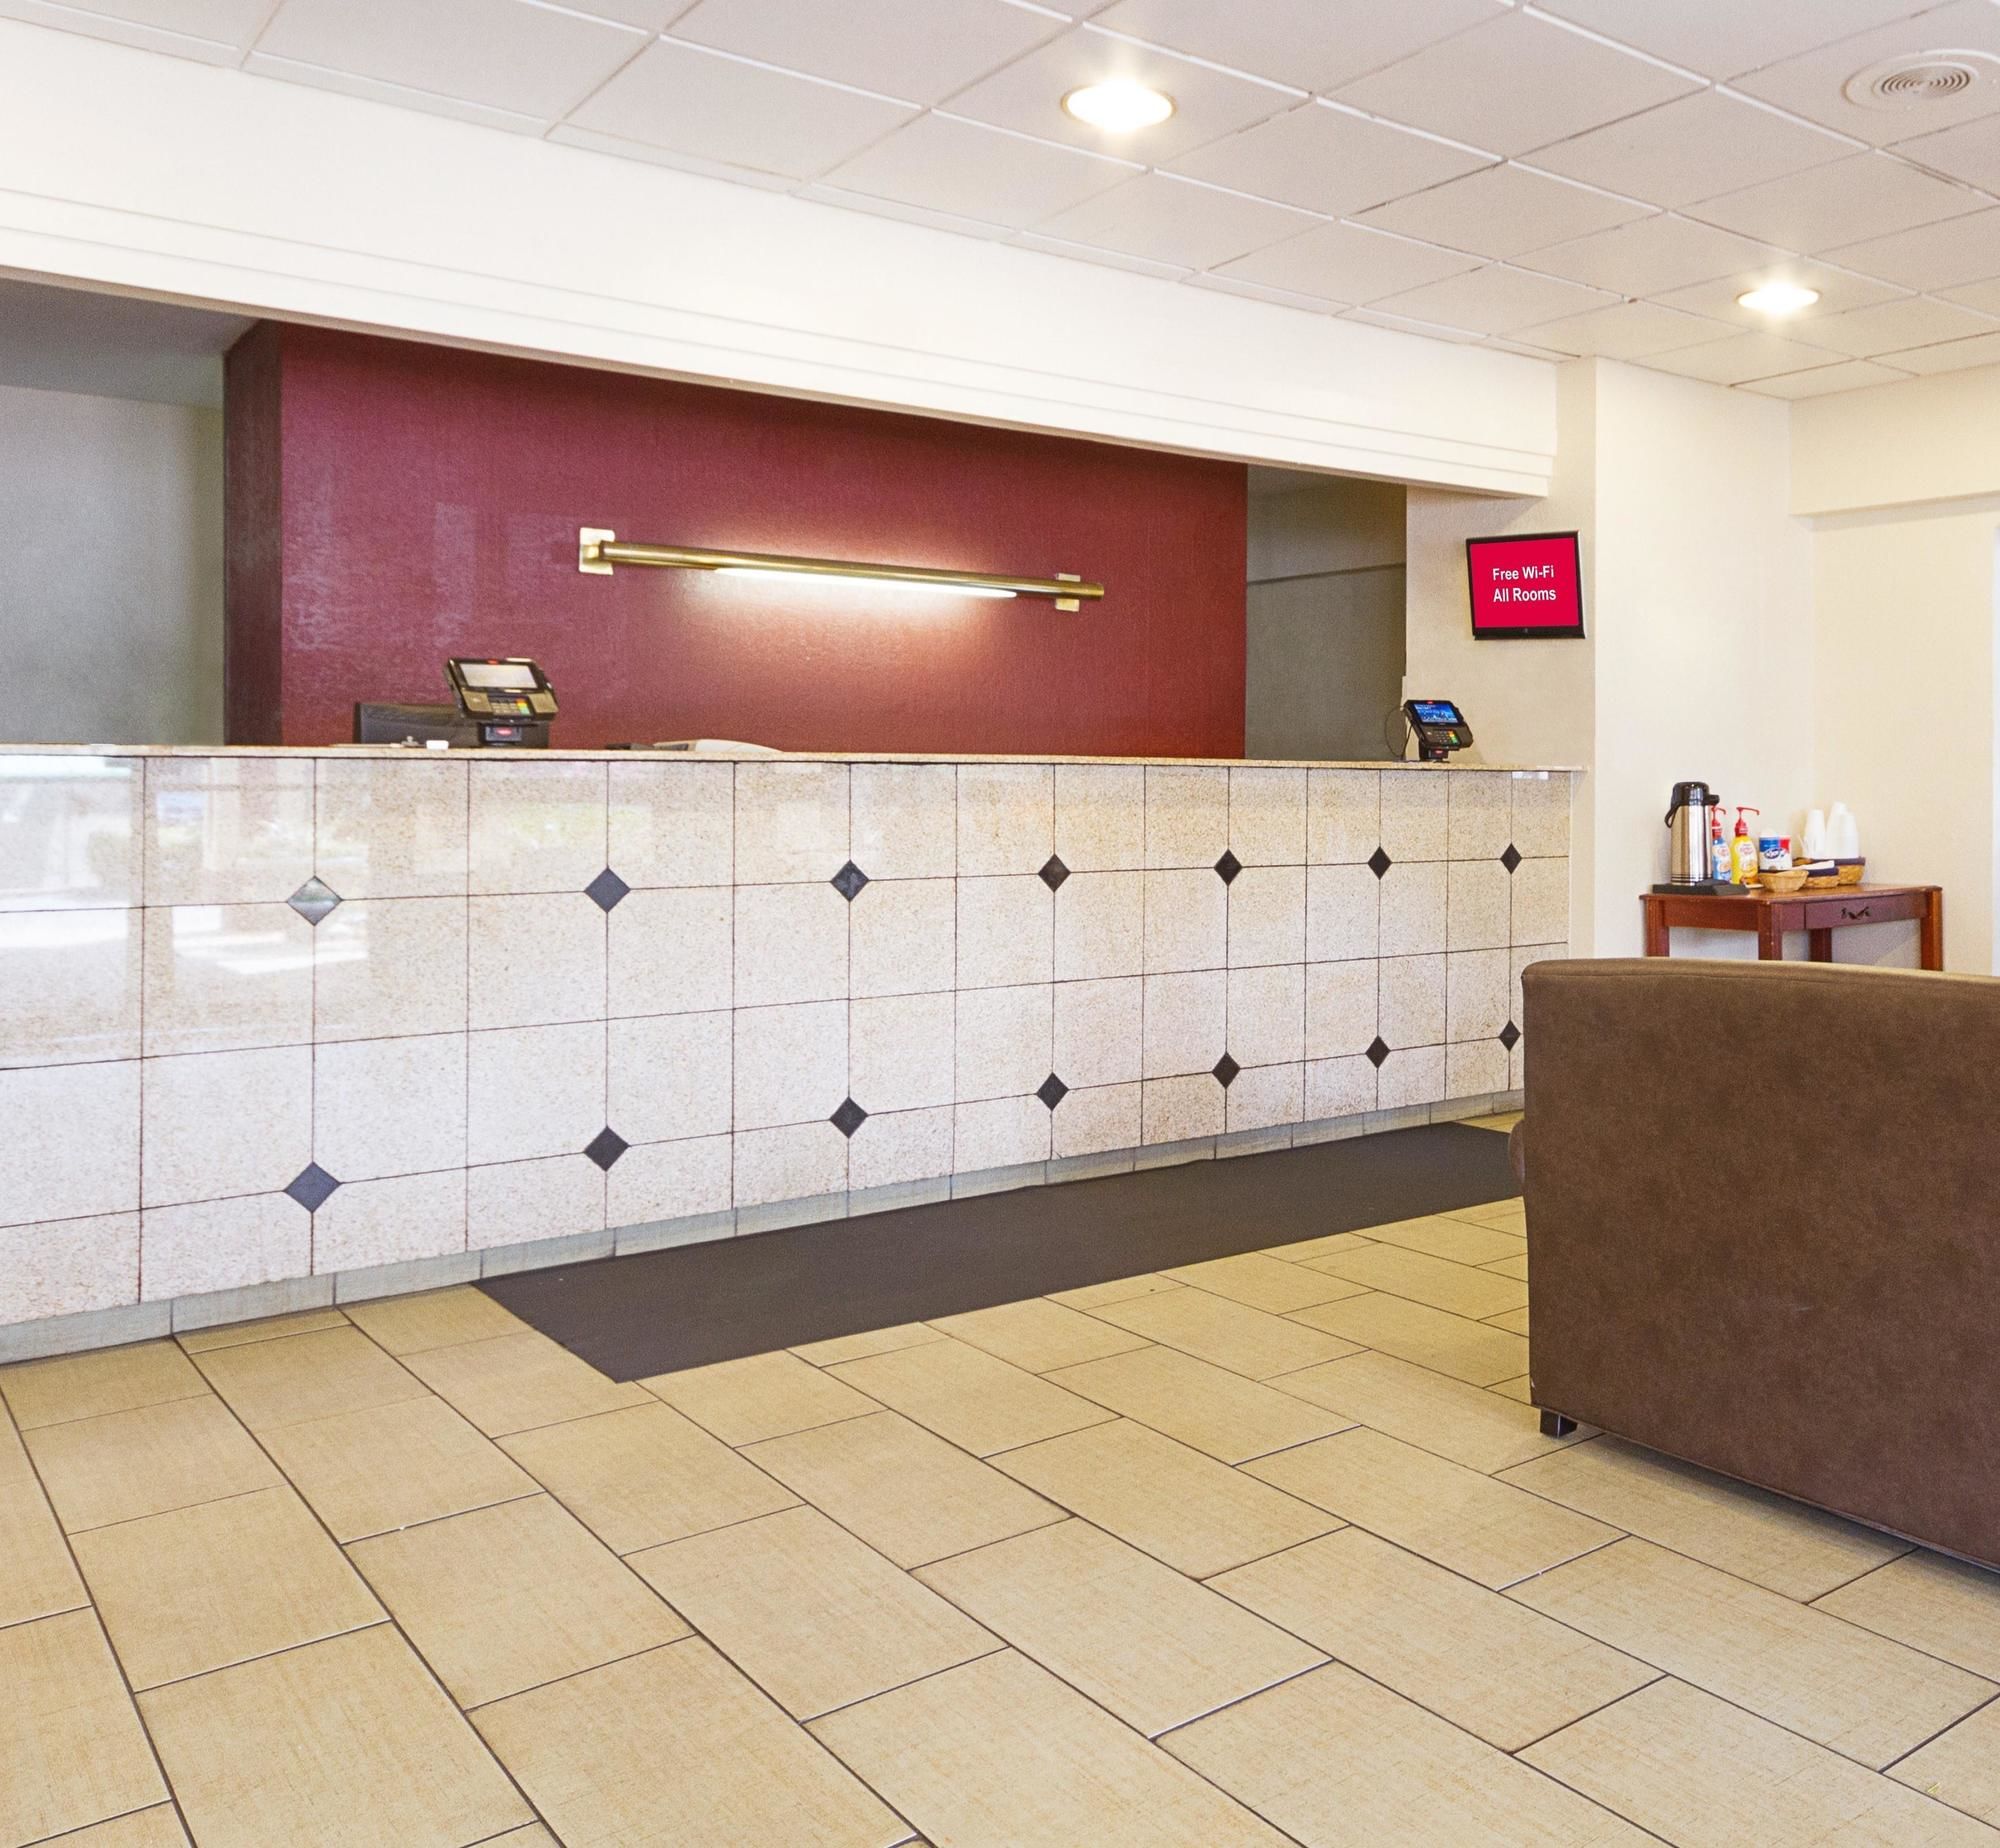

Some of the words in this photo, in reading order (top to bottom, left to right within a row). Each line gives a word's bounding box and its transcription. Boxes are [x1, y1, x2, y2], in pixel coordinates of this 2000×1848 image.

[1492, 567, 1519, 581] Free
[1522, 565, 1555, 579] Wi-Fi
[1493, 588, 1509, 602] All
[1512, 587, 1557, 602] Rooms
